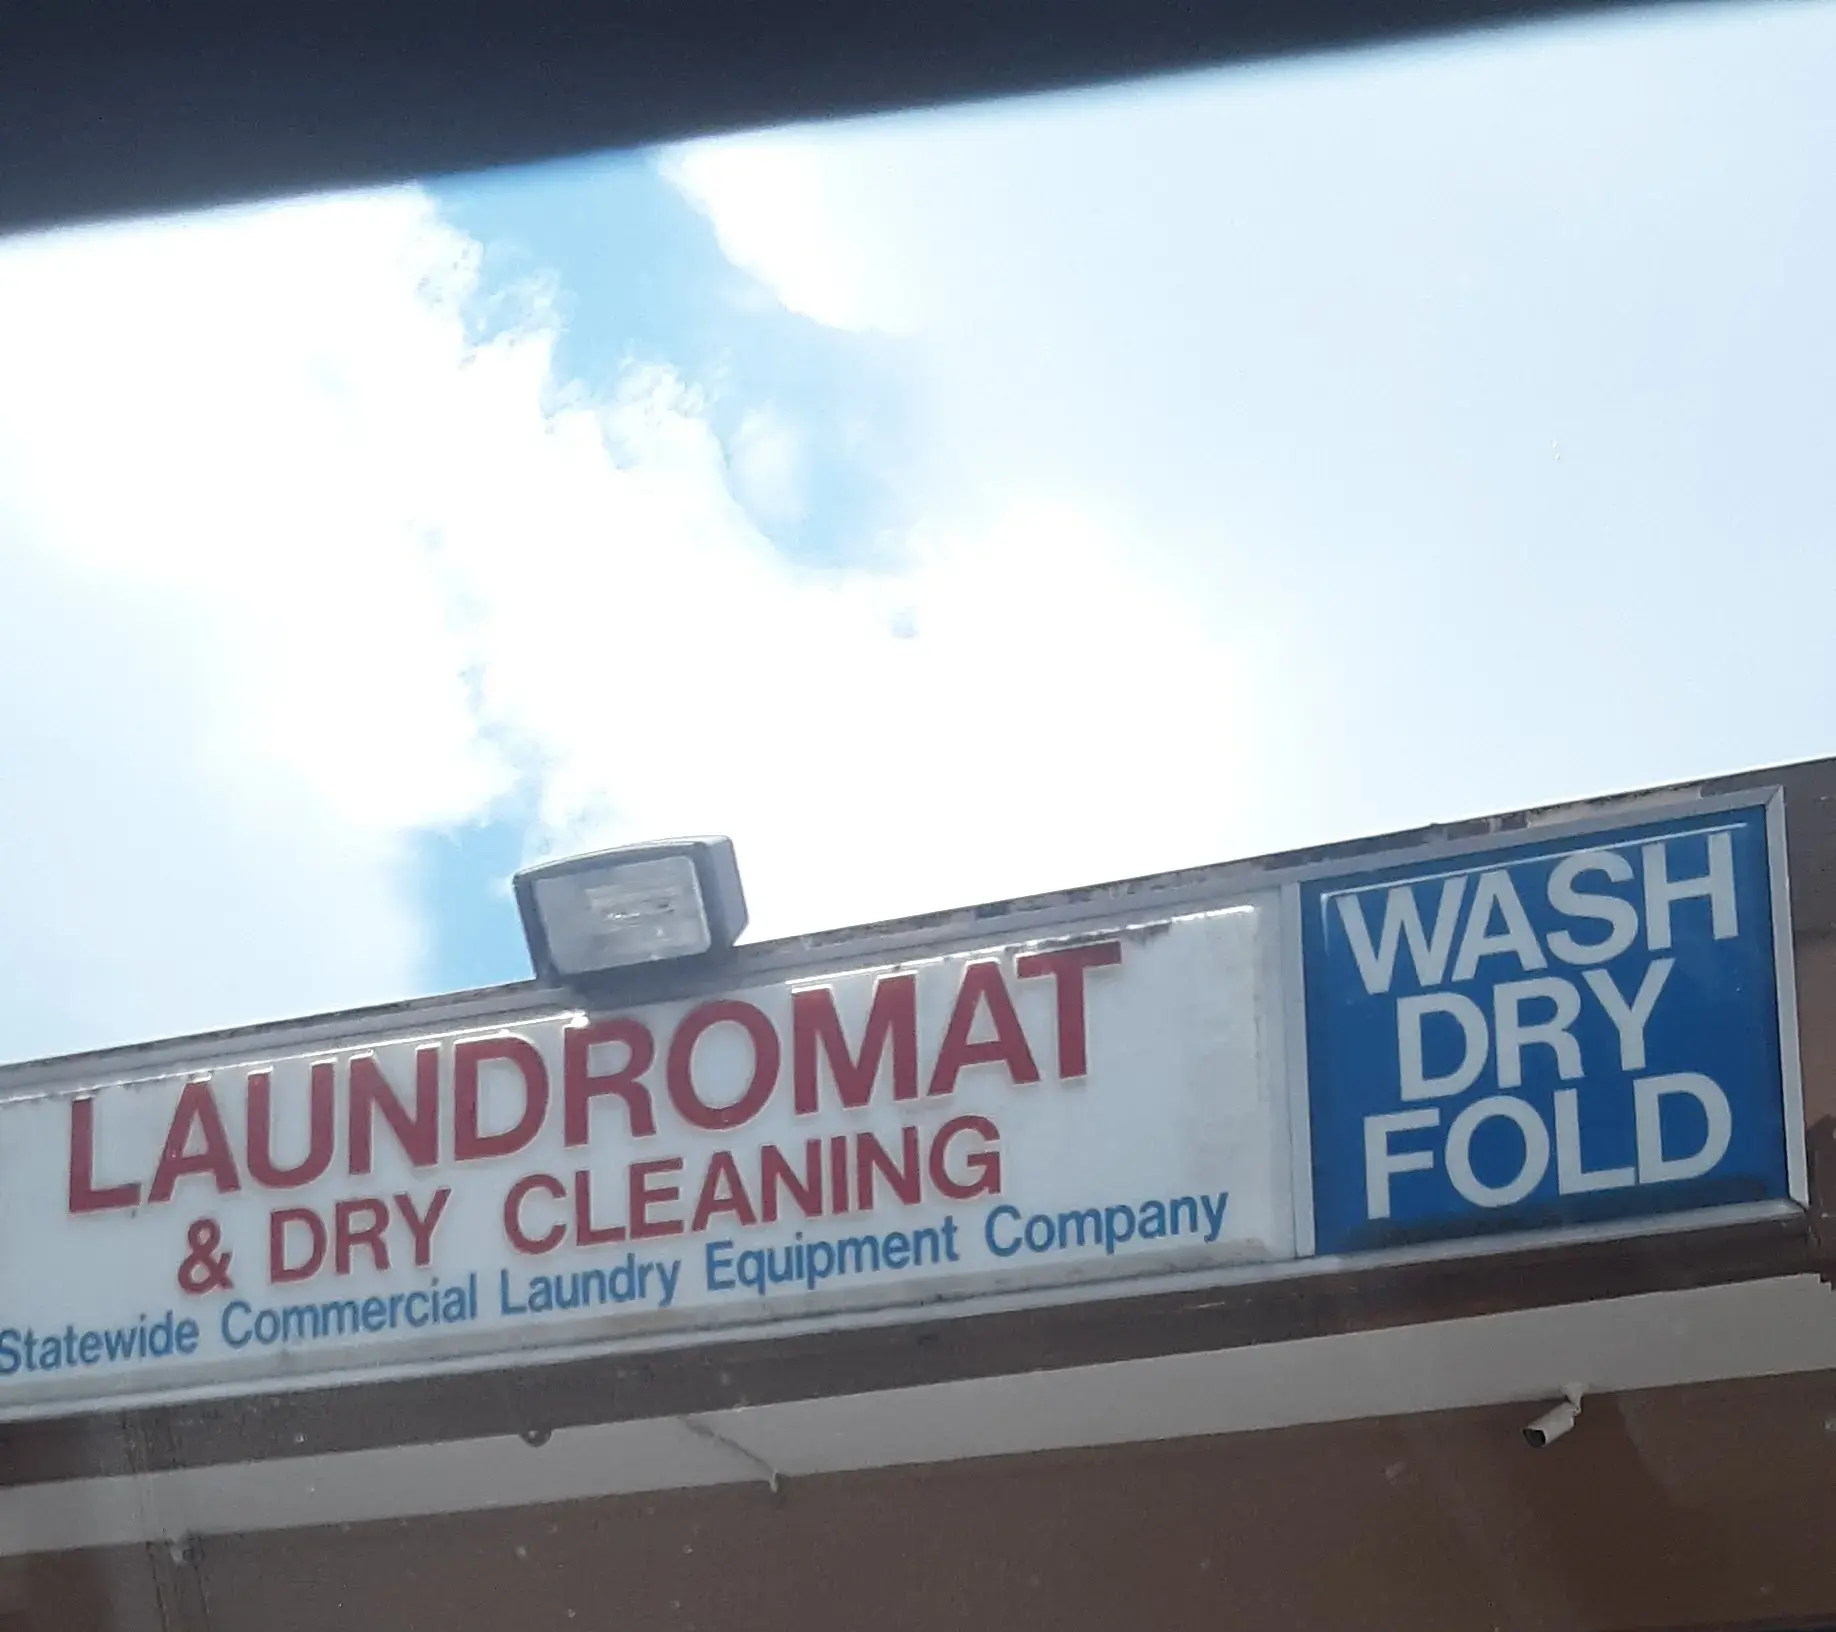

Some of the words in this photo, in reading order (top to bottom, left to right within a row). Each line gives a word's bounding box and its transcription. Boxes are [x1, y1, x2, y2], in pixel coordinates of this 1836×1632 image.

[1336, 832, 1739, 995] WASH
[69, 941, 1122, 1214] LAUNDROMAT
[1397, 957, 1676, 1101] DRY
[177, 1218, 233, 1294] &
[270, 1188, 451, 1284] DRY
[504, 1115, 1001, 1254] CLEANING
[1363, 1072, 1732, 1219] FOLD
[0, 1309, 199, 1375] Statewide
[221, 1273, 478, 1348] Commercial
[500, 1254, 681, 1316] Laundry
[706, 1216, 959, 1294] Equipment
[984, 1192, 1228, 1258] Company
